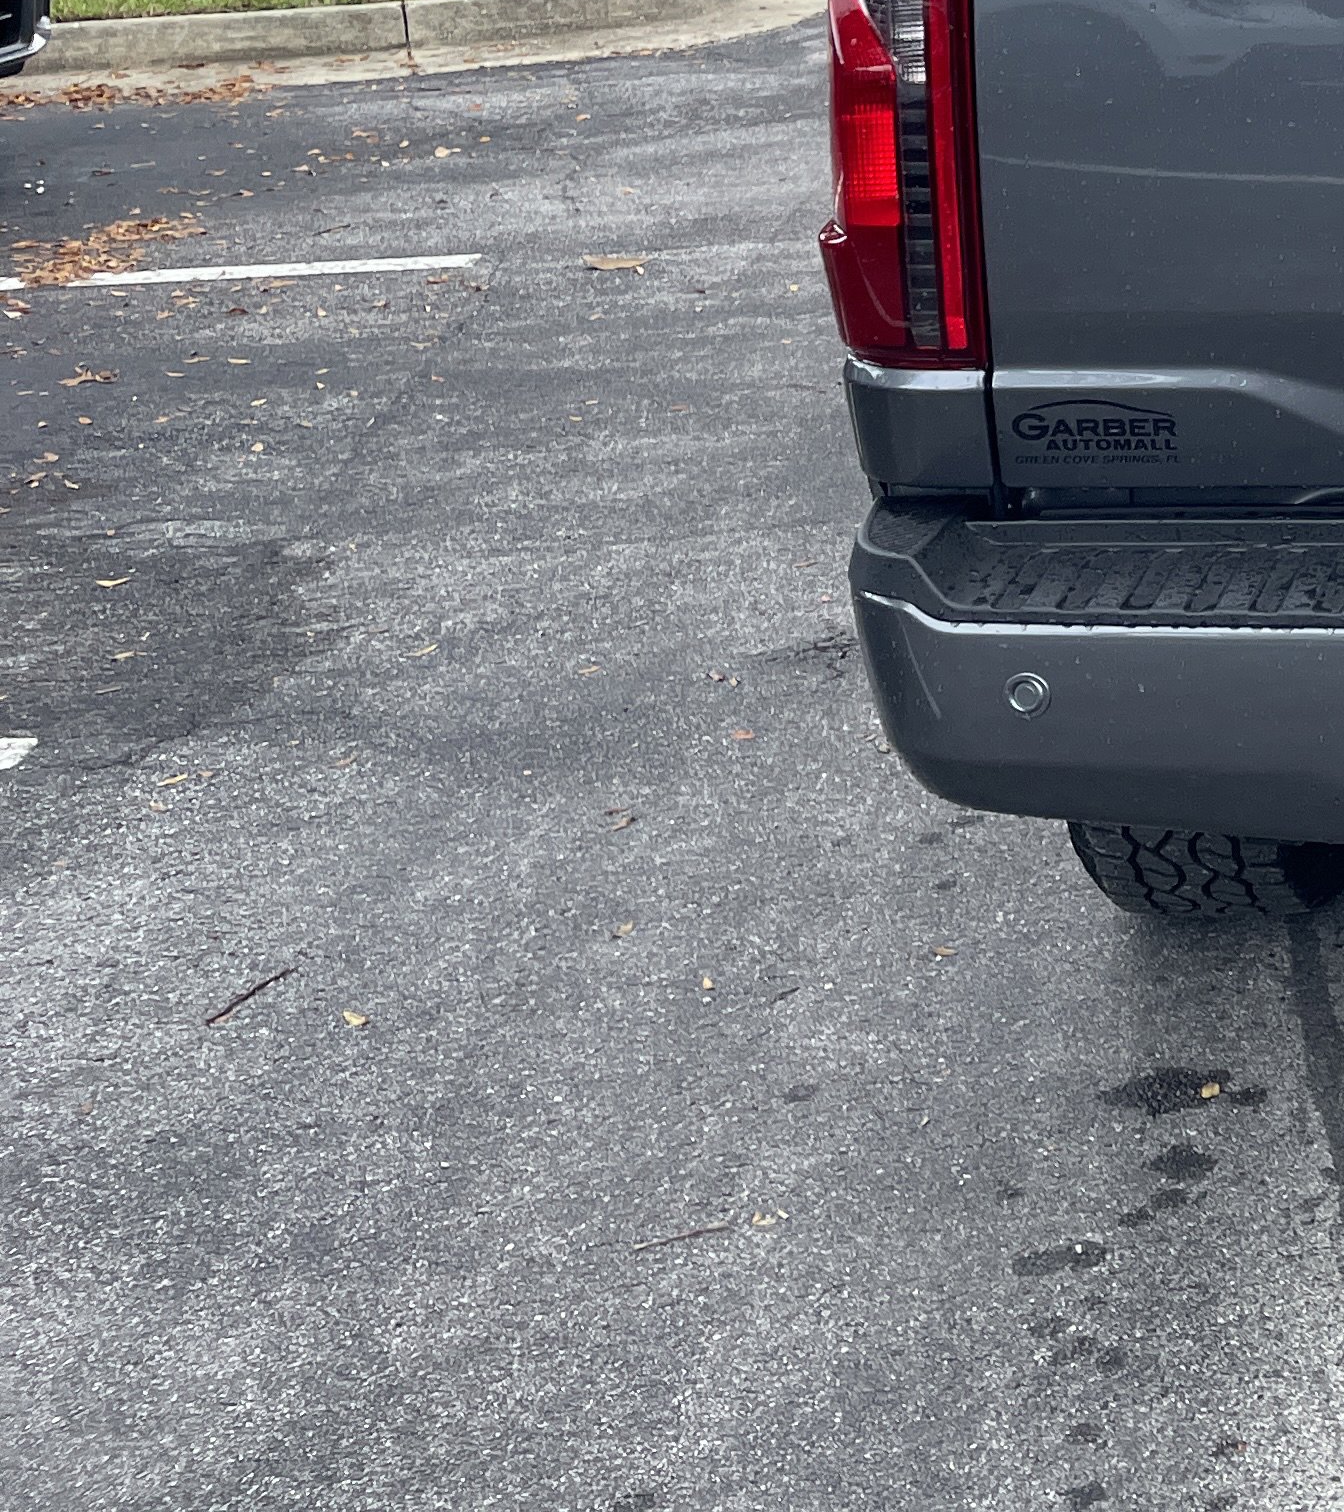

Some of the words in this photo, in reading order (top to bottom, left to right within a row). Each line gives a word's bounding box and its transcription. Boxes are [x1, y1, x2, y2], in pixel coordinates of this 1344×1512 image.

[1011, 412, 1177, 440] GARBER
[1046, 439, 1178, 451] AUTOMALL
[1015, 455, 1060, 465] GREEN
[1063, 455, 1099, 465] COVE
